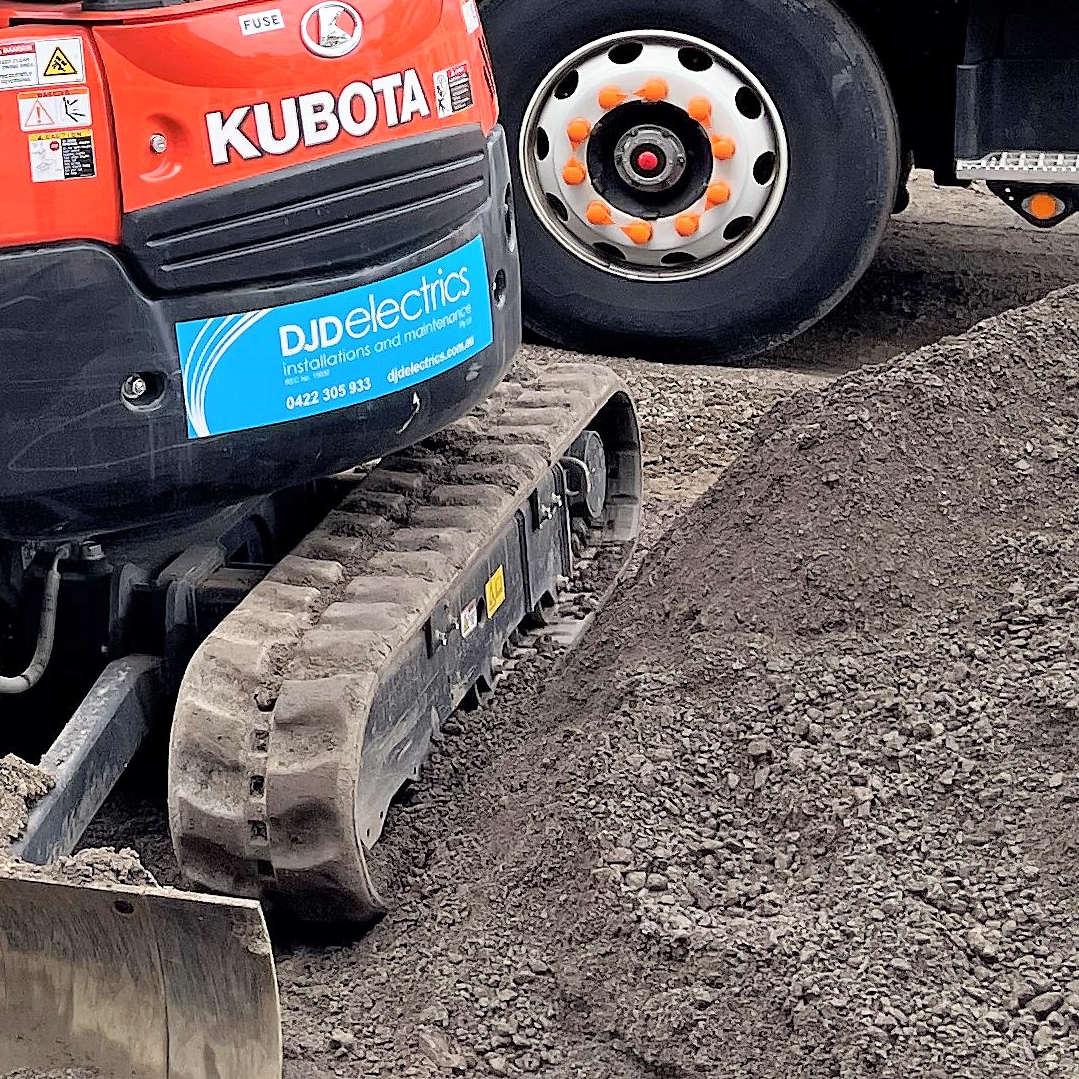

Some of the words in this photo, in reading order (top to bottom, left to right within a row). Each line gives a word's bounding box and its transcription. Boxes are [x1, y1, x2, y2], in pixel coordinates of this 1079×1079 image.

[243, 14, 280, 31] FUSE
[205, 68, 430, 166] KUBOTA
[283, 345, 371, 376] installations
[374, 333, 402, 352] and
[404, 303, 472, 343] maintenance
[286, 390, 319, 410] 0422
[322, 383, 346, 401] 305
[348, 377, 372, 394] 933
[387, 335, 475, 384] djdelectrics.com.au
